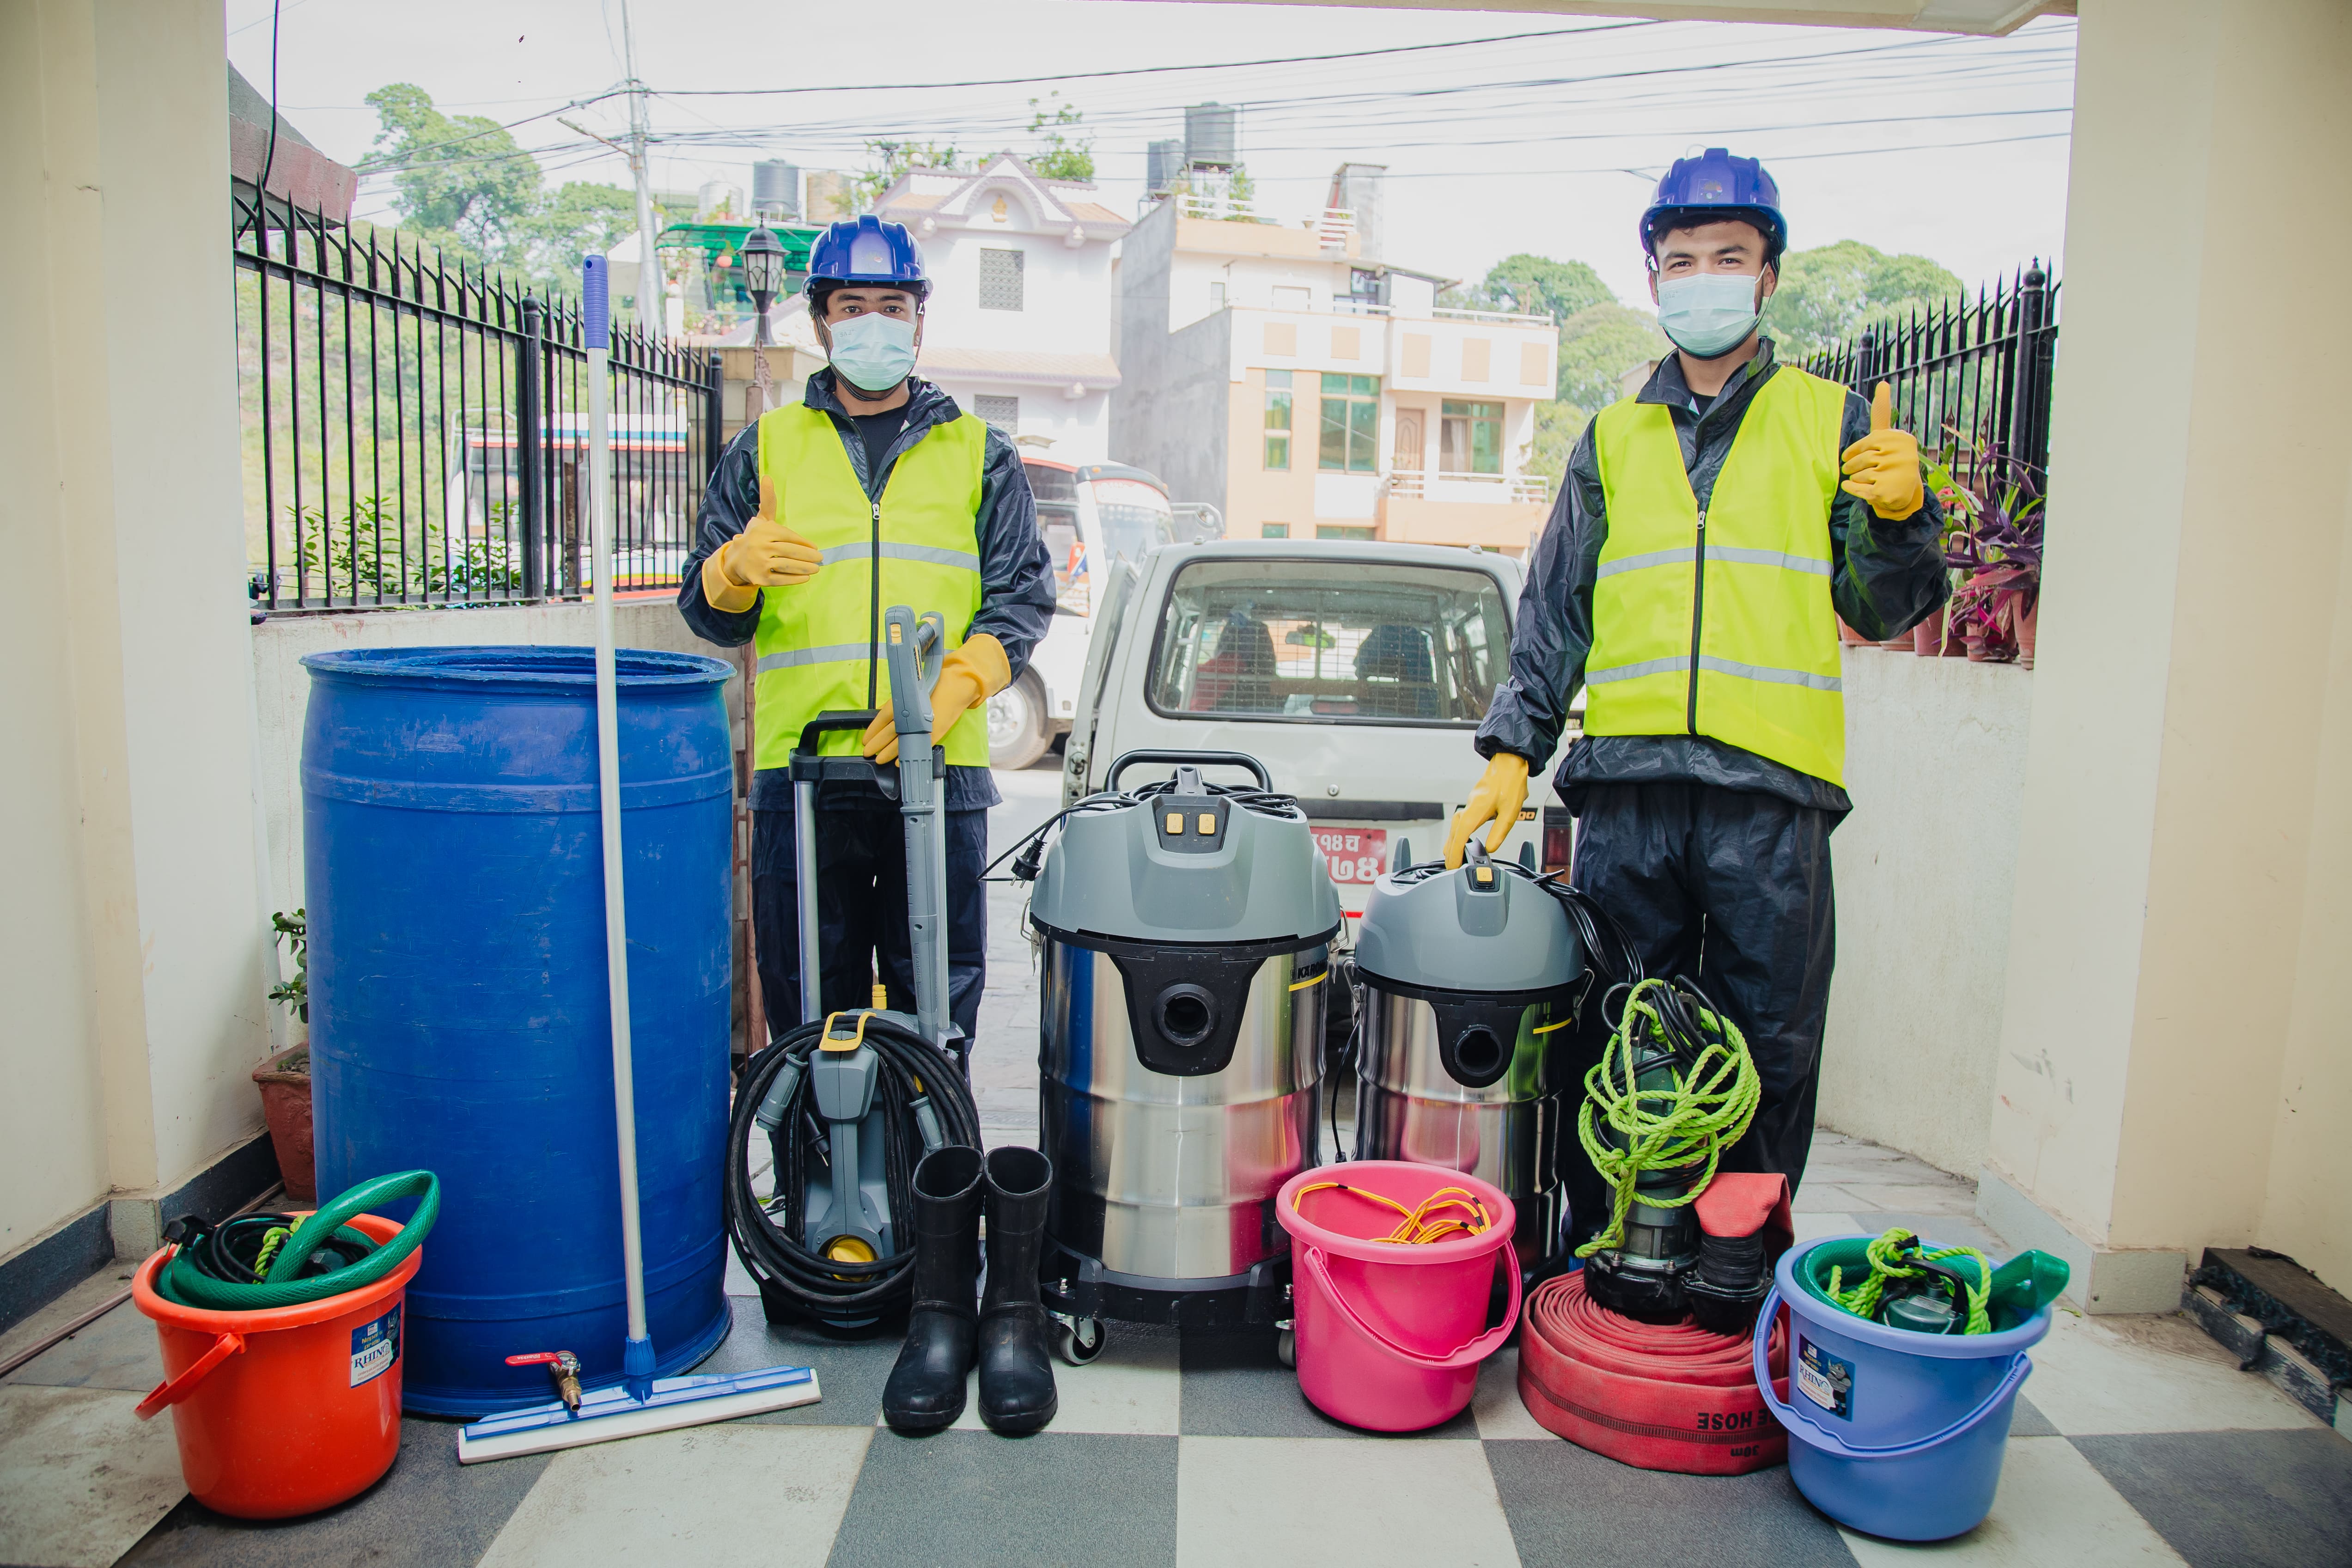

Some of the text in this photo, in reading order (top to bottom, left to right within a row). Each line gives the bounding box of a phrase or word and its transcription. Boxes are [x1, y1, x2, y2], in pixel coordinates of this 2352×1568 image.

[1326, 856, 1379, 882] ७४
[354, 1343, 390, 1368] RHINO
[1697, 1411, 1753, 1430] HOSE
[1730, 1445, 1760, 1458] 30m
